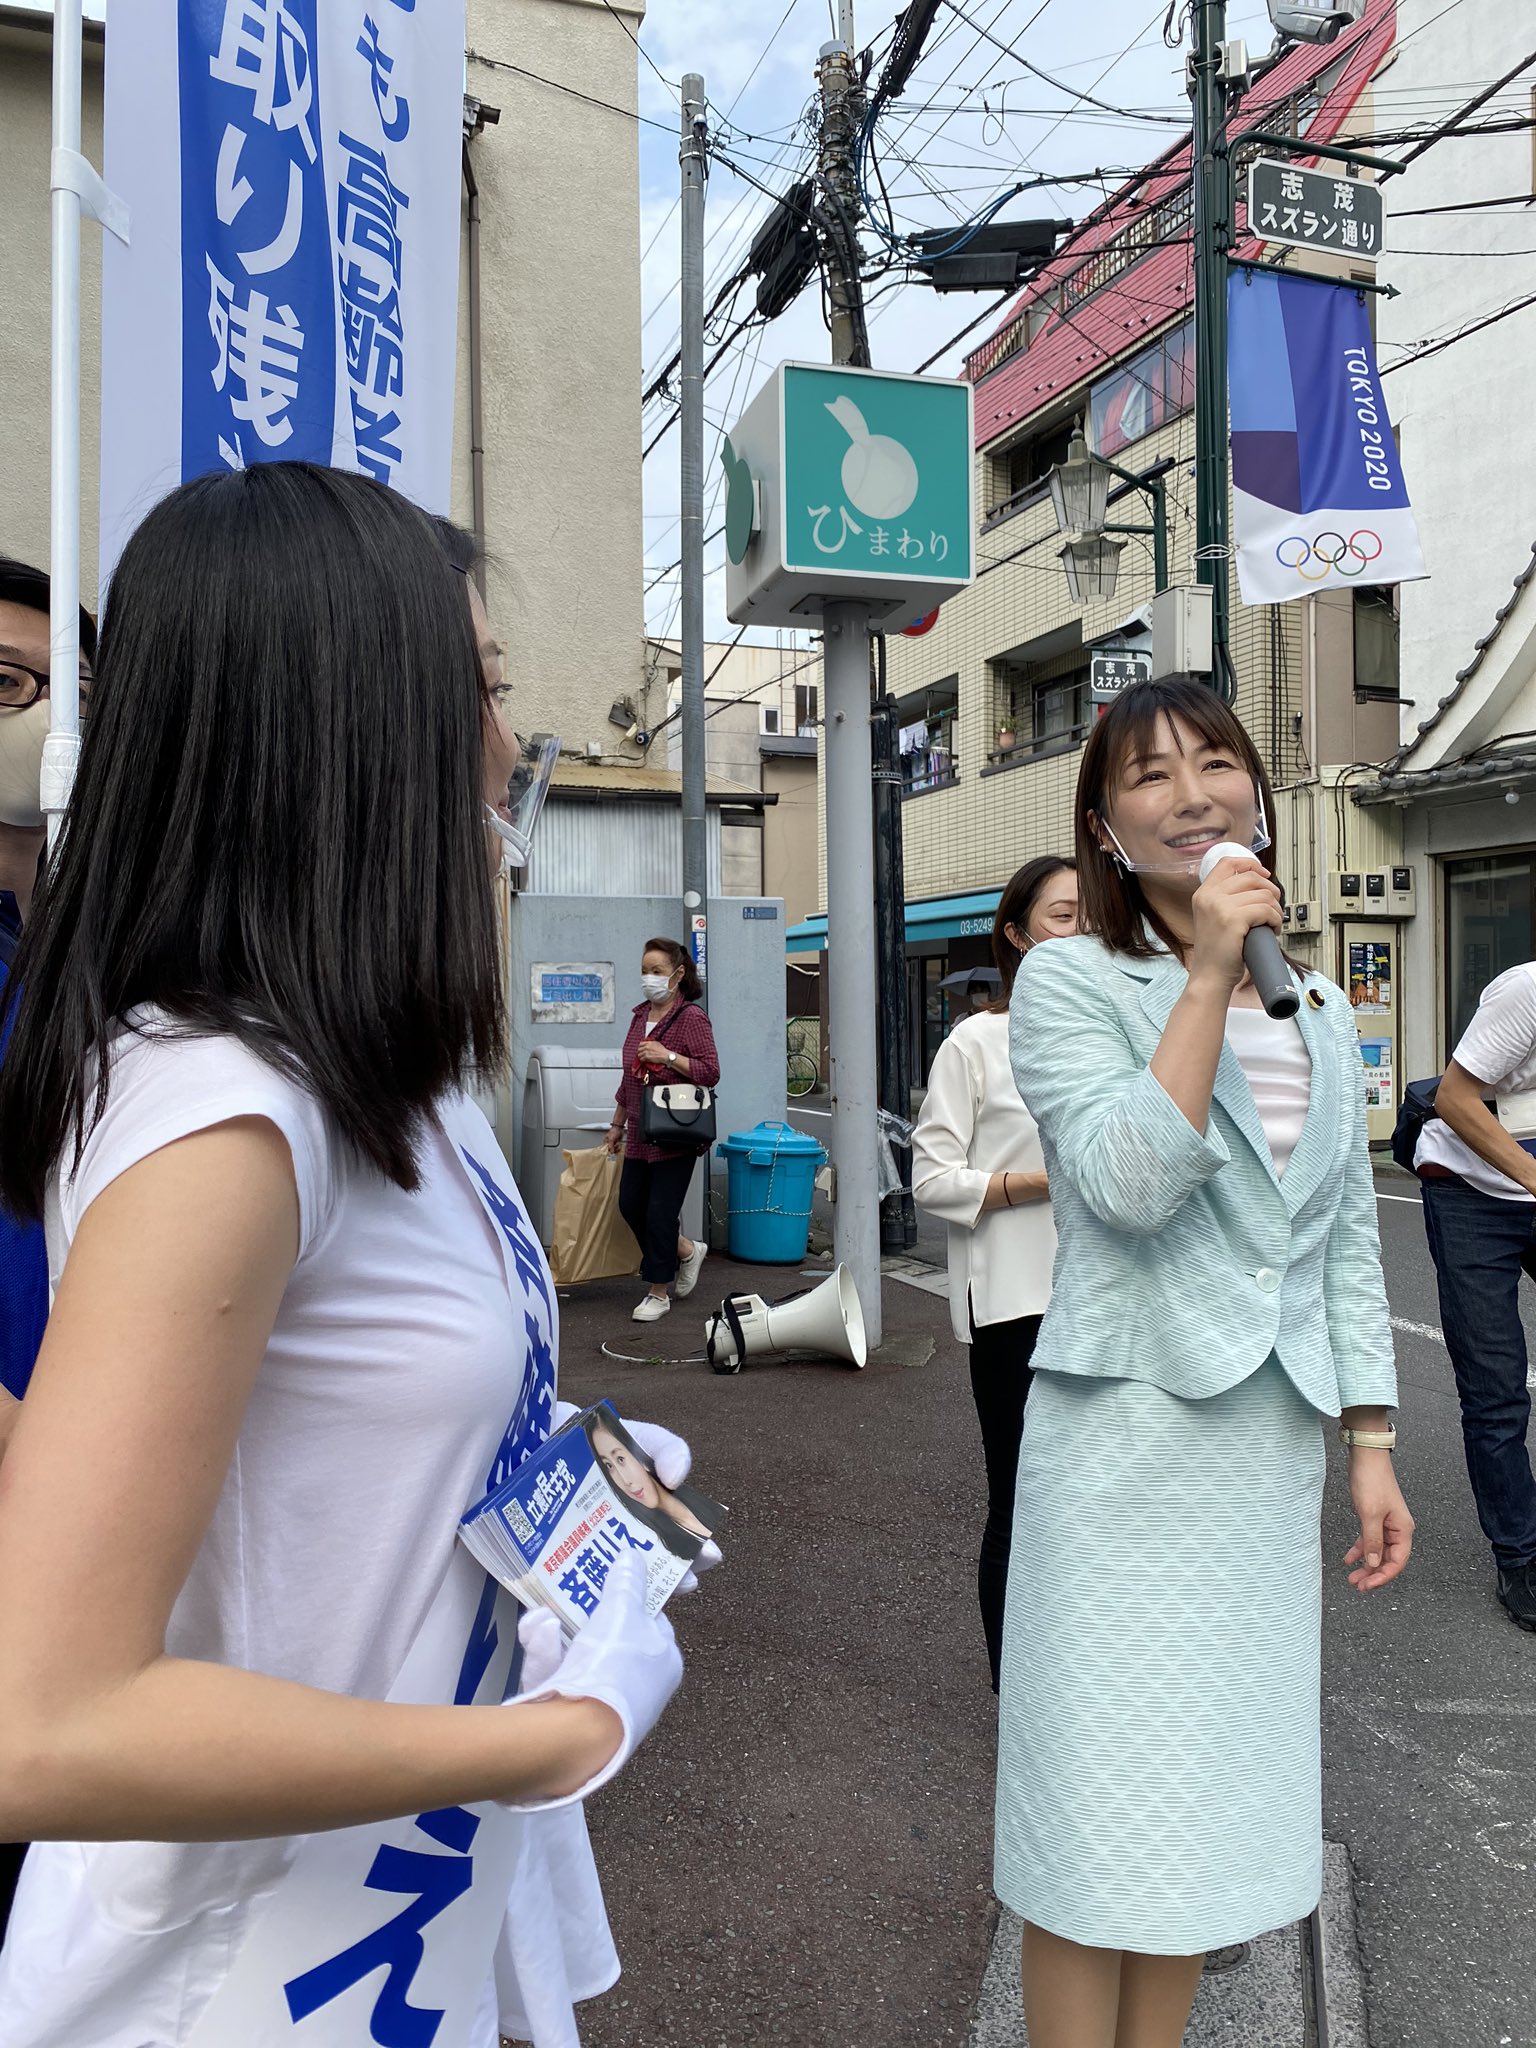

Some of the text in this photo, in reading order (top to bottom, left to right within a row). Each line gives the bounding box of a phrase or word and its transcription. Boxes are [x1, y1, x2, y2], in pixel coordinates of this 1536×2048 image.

[337, 0, 416, 487] も高齢者
[1261, 202, 1375, 250] スズラン通り
[1344, 346, 1392, 491] TOKYO 2020
[807, 504, 948, 562] ひまわり
[1096, 676, 1144, 689] スズラン
[960, 917, 993, 935] 03-5249
[526, 1458, 576, 1526] 立憲民主党
[558, 1517, 654, 1619] 斉藤りえ
